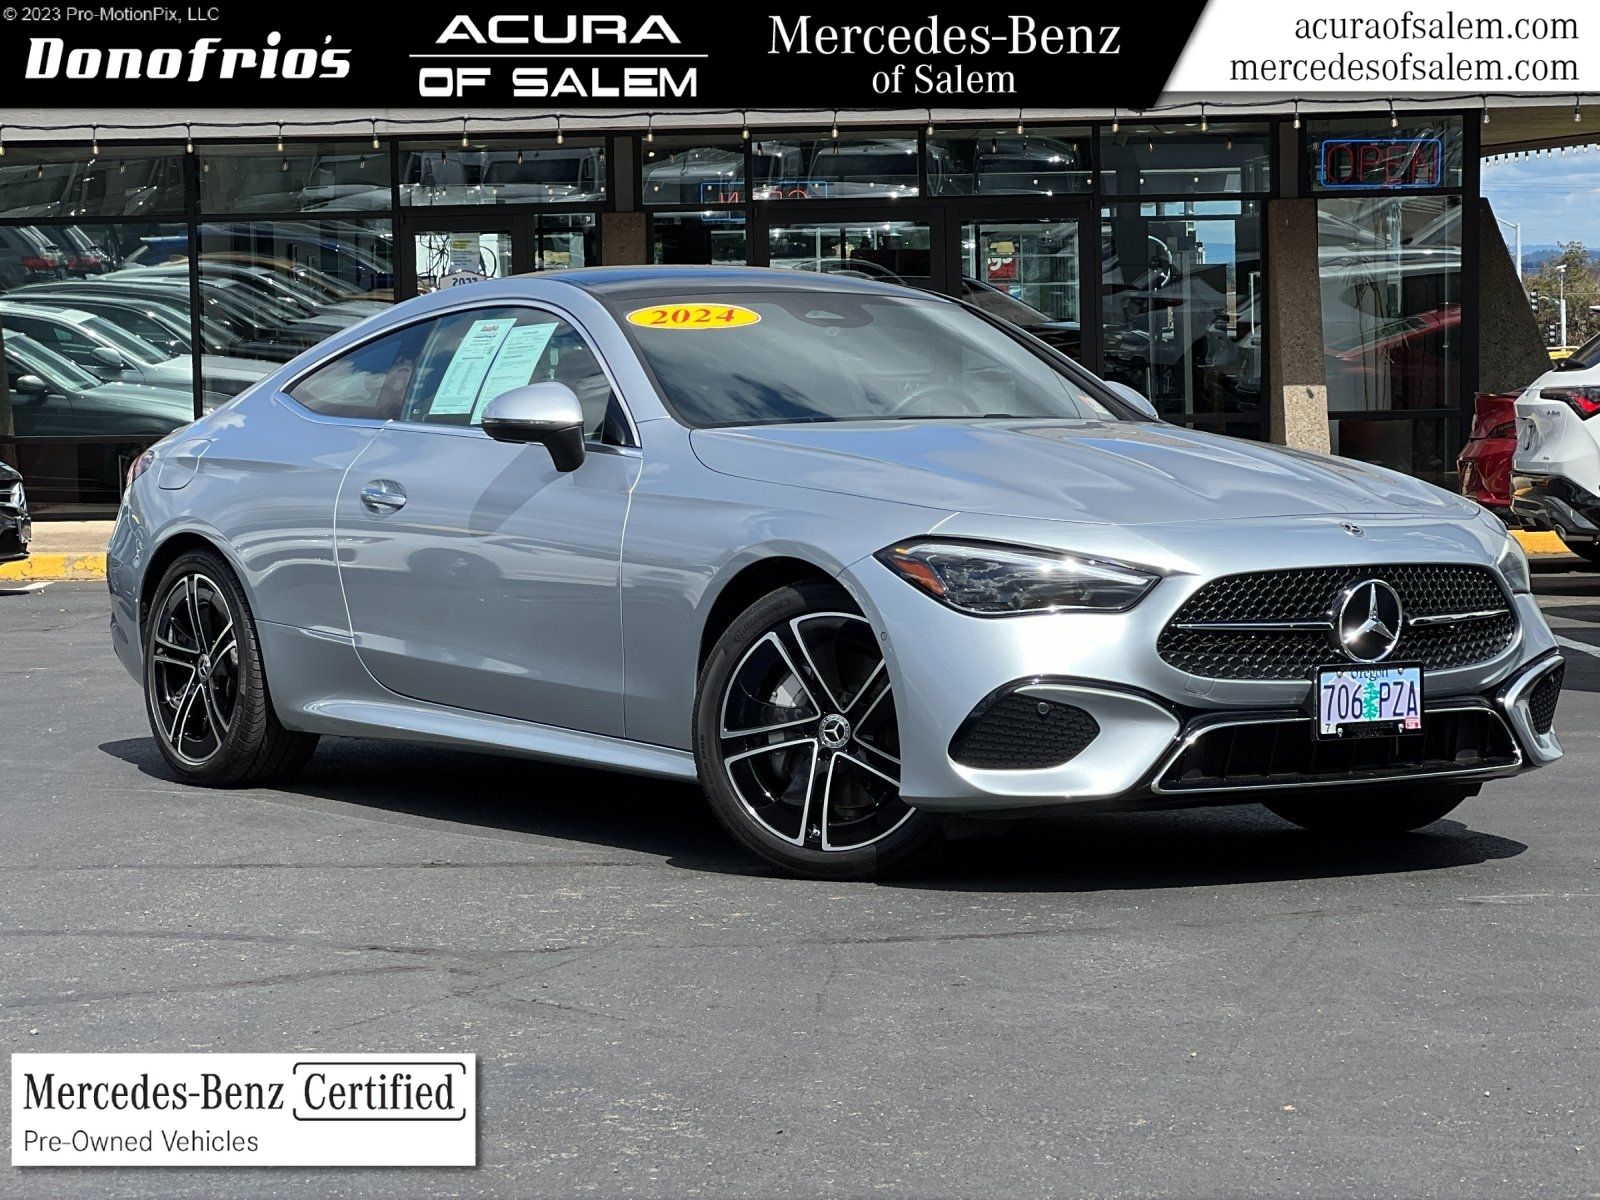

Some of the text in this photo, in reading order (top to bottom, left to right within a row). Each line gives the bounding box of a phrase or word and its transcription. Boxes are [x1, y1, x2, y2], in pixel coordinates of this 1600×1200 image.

[1327, 144, 1437, 185] OPEN
[650, 307, 735, 325] 2024
[1323, 681, 1418, 721] 706 PZA
